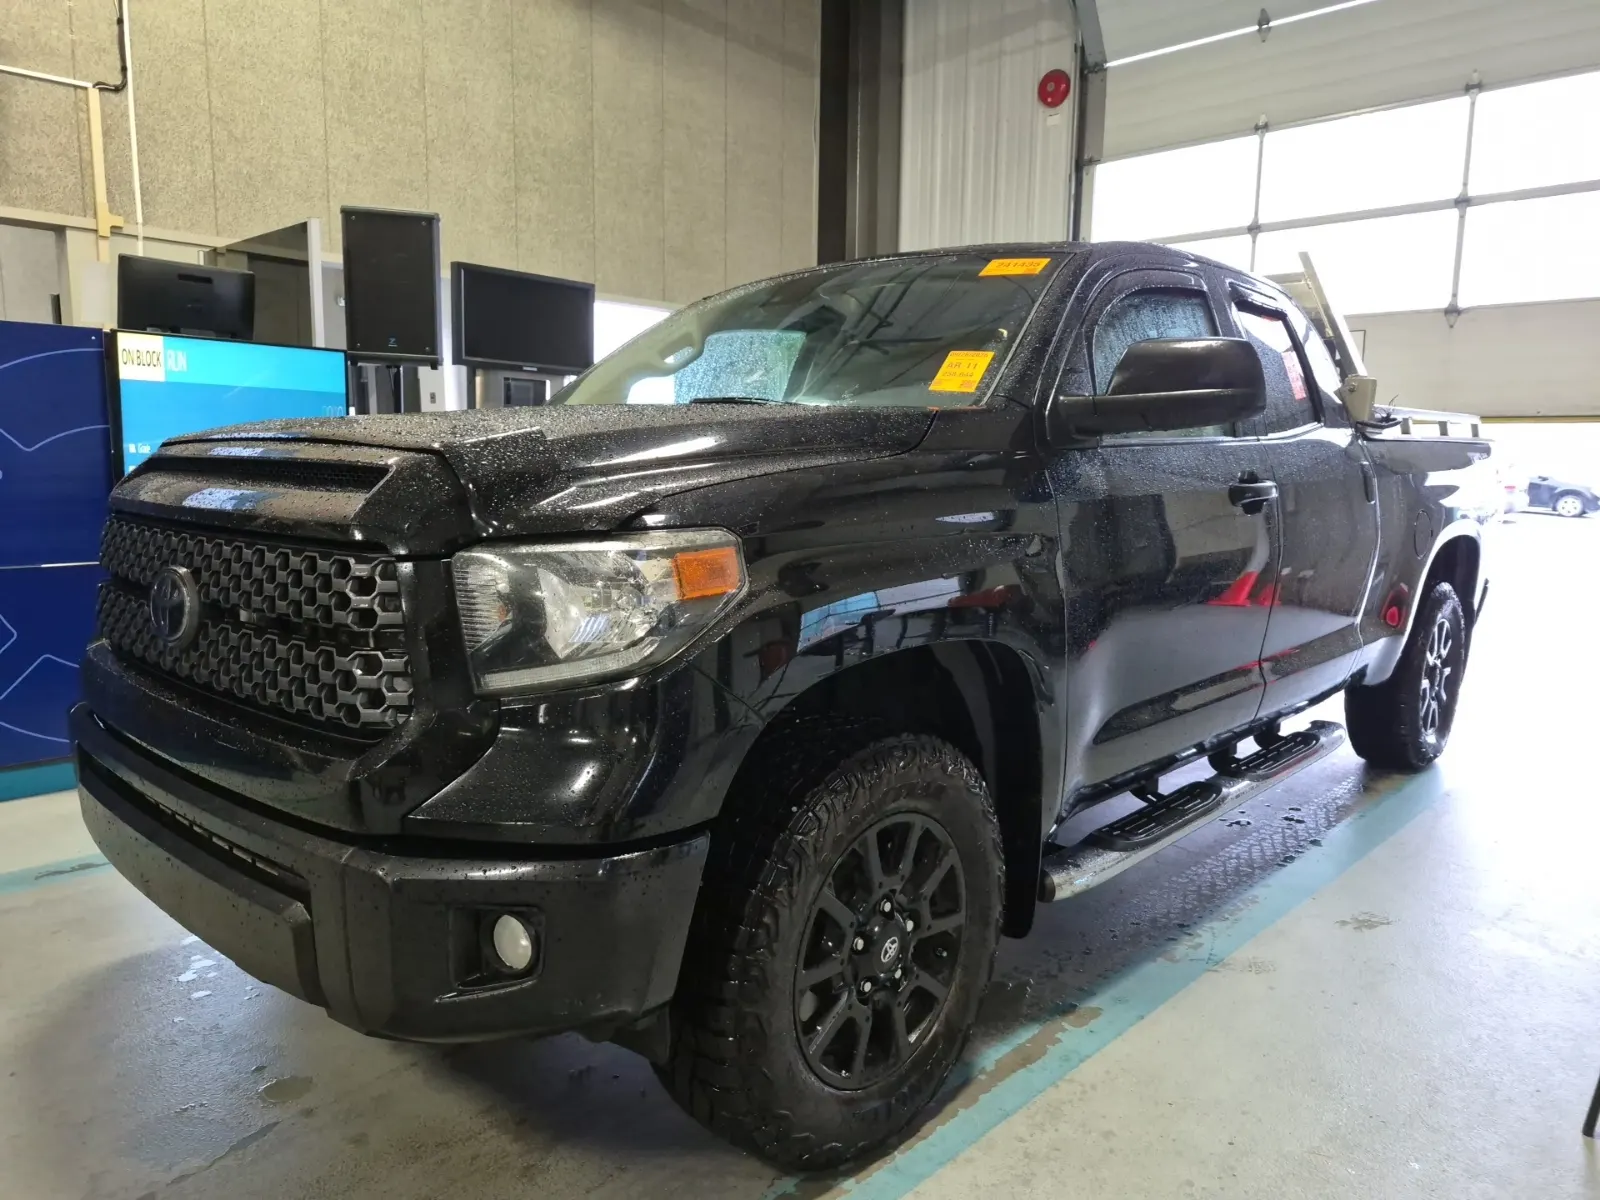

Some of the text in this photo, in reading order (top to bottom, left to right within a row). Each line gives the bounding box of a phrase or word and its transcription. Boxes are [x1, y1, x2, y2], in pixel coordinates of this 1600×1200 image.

[121, 348, 162, 368] ON BLOCK
[167, 349, 188, 372] RUN
